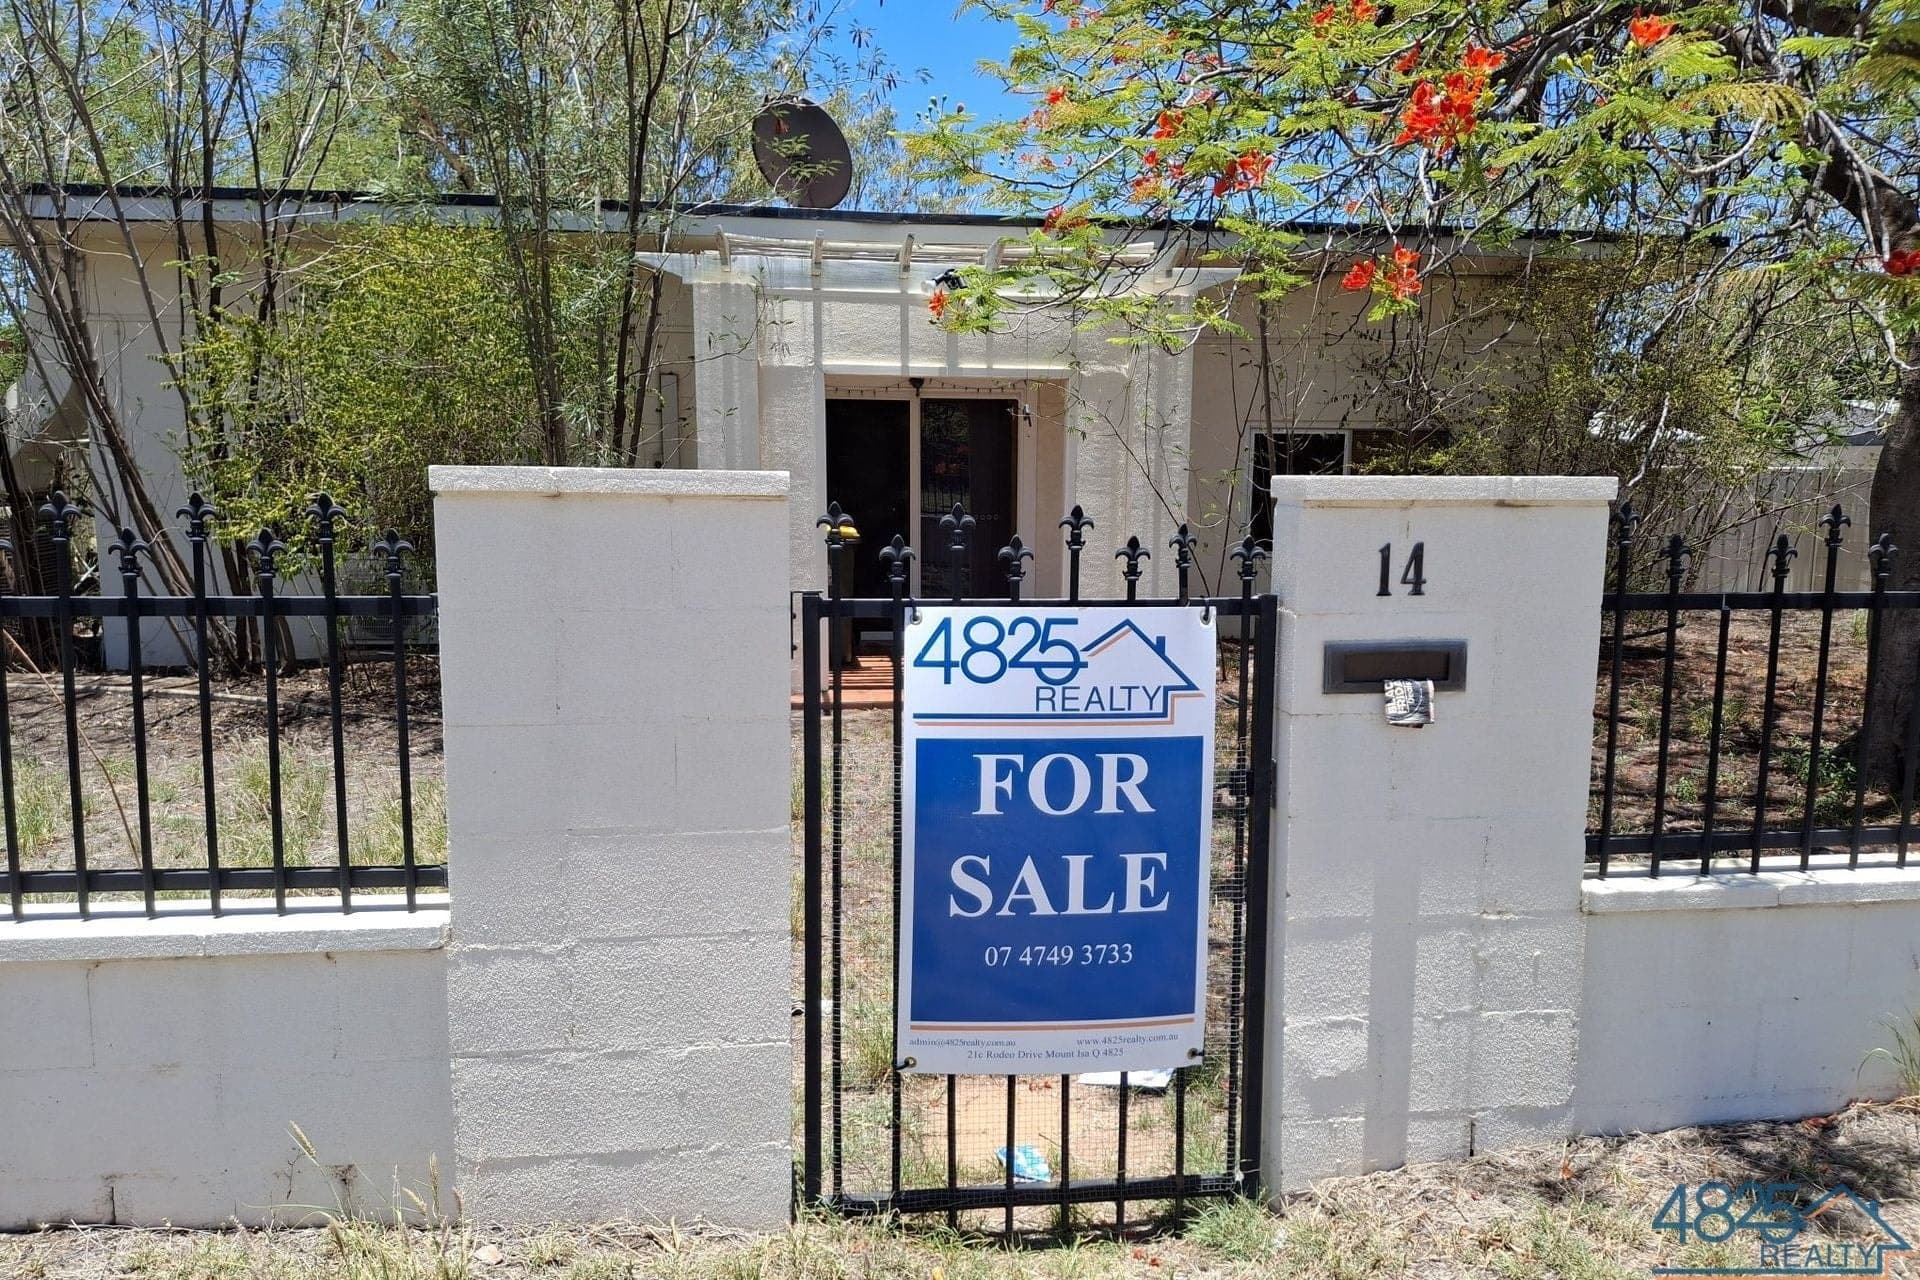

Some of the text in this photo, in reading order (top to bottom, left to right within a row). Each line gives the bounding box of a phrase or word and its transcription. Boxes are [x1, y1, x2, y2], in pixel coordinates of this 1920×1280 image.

[1376, 542, 1427, 596] 14
[913, 615, 1089, 686] 4825
[1035, 685, 1163, 712] REALTY
[1384, 679, 1398, 714] BLAC
[1393, 680, 1409, 714] FRIDA
[972, 752, 1156, 816] FOR
[949, 852, 1170, 918] SALE
[984, 943, 1133, 966] 07 4749 3733
[909, 1037, 1017, 1048] admin@4825realty.com.au
[986, 1050, 1015, 1059] Rodeo
[1018, 1049, 1043, 1059] Drive
[1045, 1049, 1074, 1058] Mount
[1077, 1049, 1090, 1058] Isa
[1092, 1048, 1100, 1058] Q
[1102, 1047, 1124, 1057] 4825
[1076, 1033, 1179, 1047] www.4825realty.com.au
